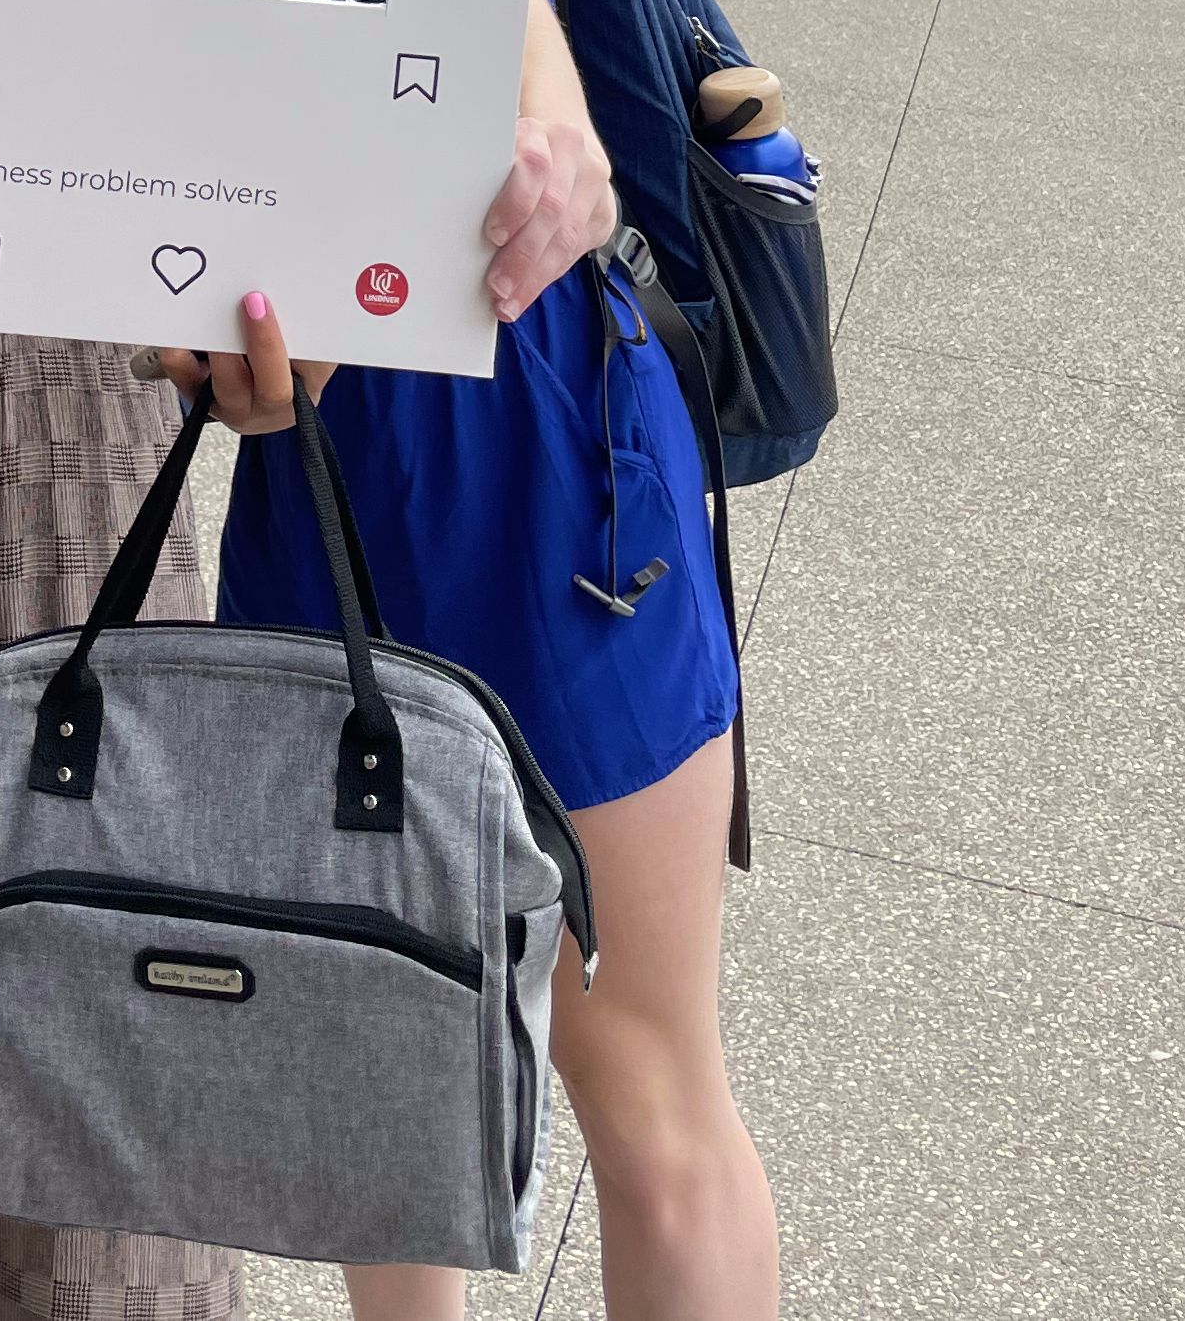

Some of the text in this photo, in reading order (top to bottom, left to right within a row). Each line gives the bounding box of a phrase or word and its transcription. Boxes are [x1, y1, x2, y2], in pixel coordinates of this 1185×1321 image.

[60, 168, 176, 198] problem
[183, 178, 277, 207] solvers
[363, 293, 400, 305] LINDNER
